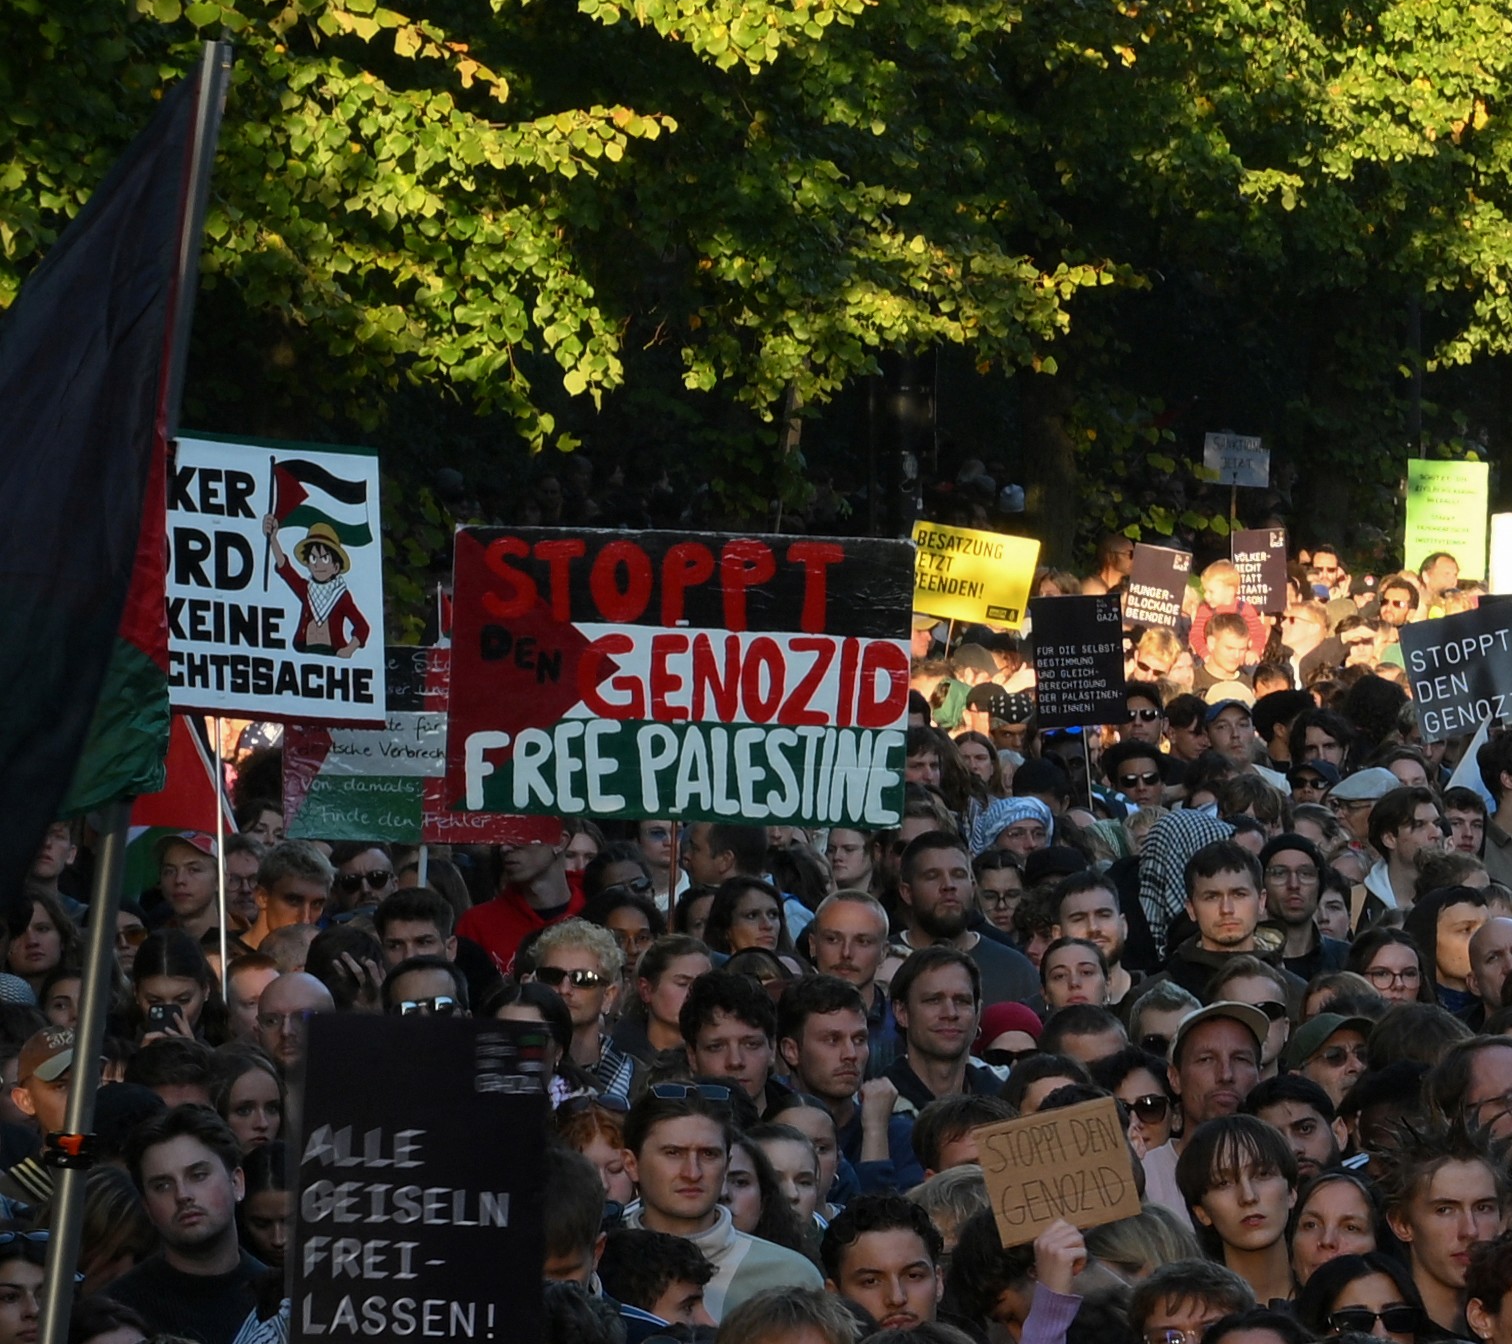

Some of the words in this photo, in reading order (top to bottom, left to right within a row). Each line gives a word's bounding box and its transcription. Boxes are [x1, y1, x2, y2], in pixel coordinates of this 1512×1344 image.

[917, 528, 1004, 560] BESATZUNG
[482, 534, 844, 633] STOPPT
[1127, 597, 1180, 615] BLOCKADE
[1126, 609, 1176, 626] BEENDEN!
[478, 624, 562, 685] DEN
[1036, 645, 1054, 656] FÜR
[1058, 645, 1076, 655] DIE
[1081, 643, 1121, 654] SELBST-
[1037, 657, 1094, 667] BESTIMMUNG
[1410, 628, 1510, 673] STOPPT
[577, 631, 909, 729] GENOZID
[1038, 669, 1055, 679] UND
[1060, 667, 1099, 678] GLEICH-
[1038, 679, 1107, 691] BERECHTIGUNG
[1416, 670, 1470, 704] DEN
[1039, 692, 1056, 703] DER
[464, 717, 626, 815] FREE
[636, 722, 904, 825] PALESTINE
[301, 1123, 428, 1169] ALLE
[985, 1120, 1065, 1174] STOPPT
[1077, 1114, 1118, 1155] DEN
[301, 1179, 511, 1228] GEISELN
[1001, 1166, 1126, 1226] GENOZID
[303, 1235, 447, 1280] FREI-
[302, 1292, 496, 1340] LASSEN!
